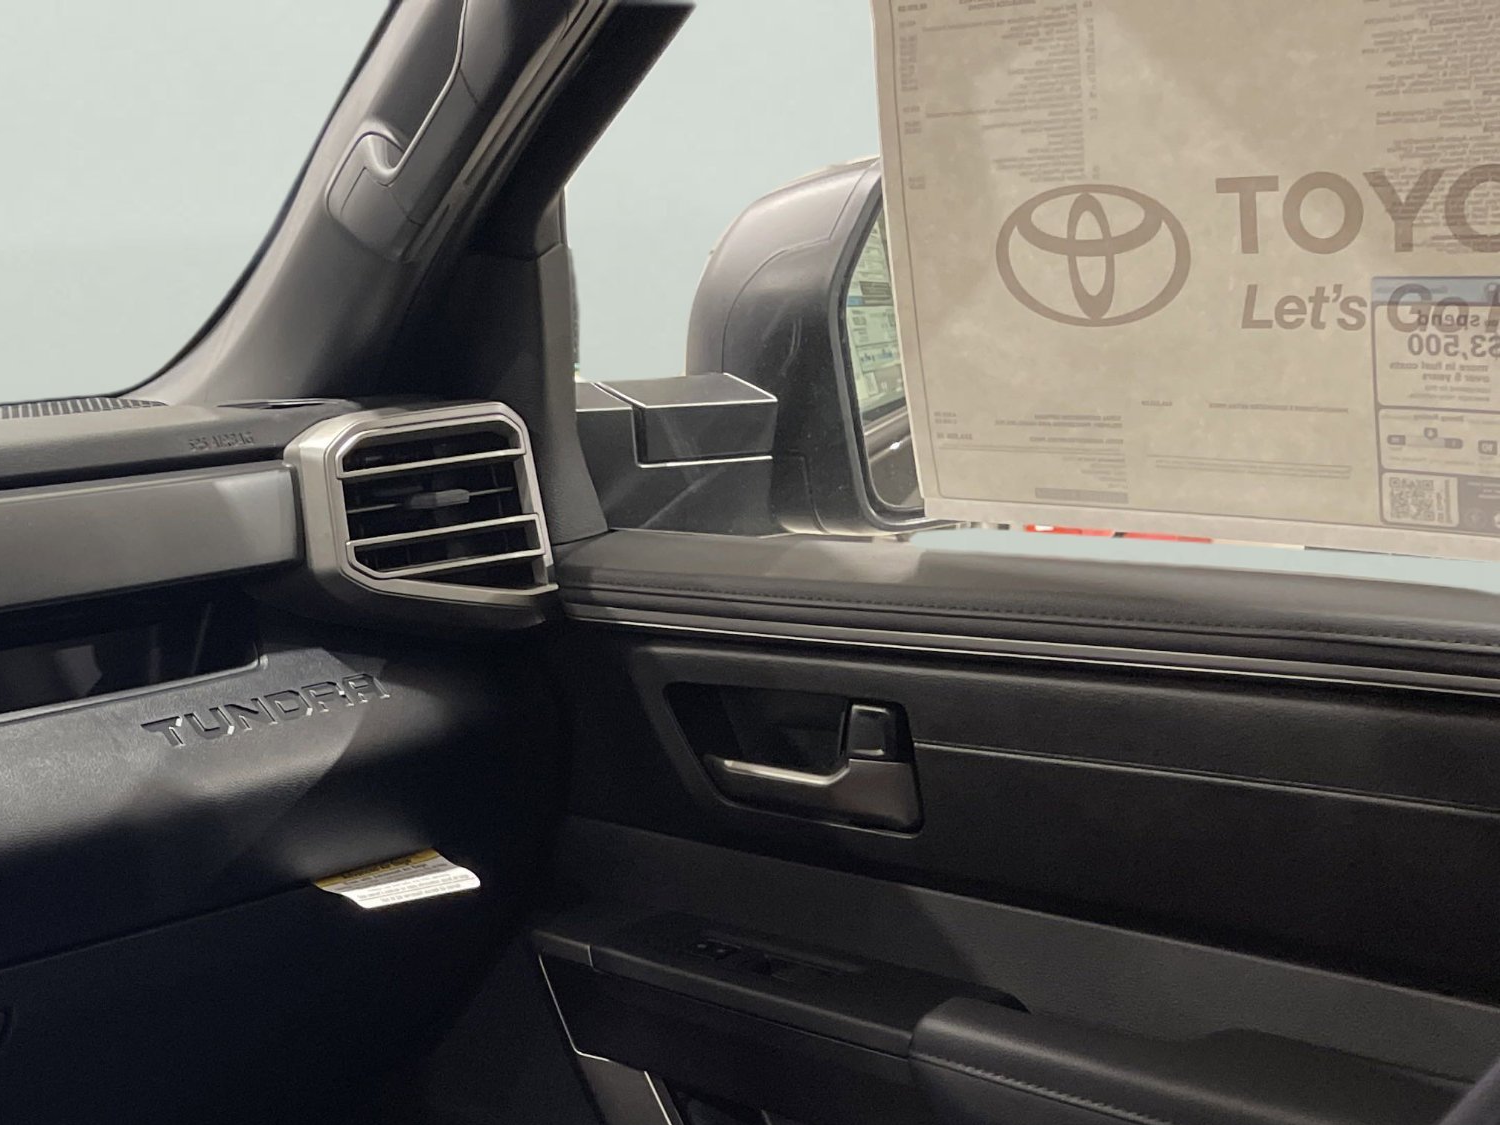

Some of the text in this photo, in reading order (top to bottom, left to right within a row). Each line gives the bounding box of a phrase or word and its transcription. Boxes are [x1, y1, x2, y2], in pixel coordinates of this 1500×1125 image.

[1241, 283, 1470, 333] Let's Go
[141, 672, 391, 748] TUNDRA
